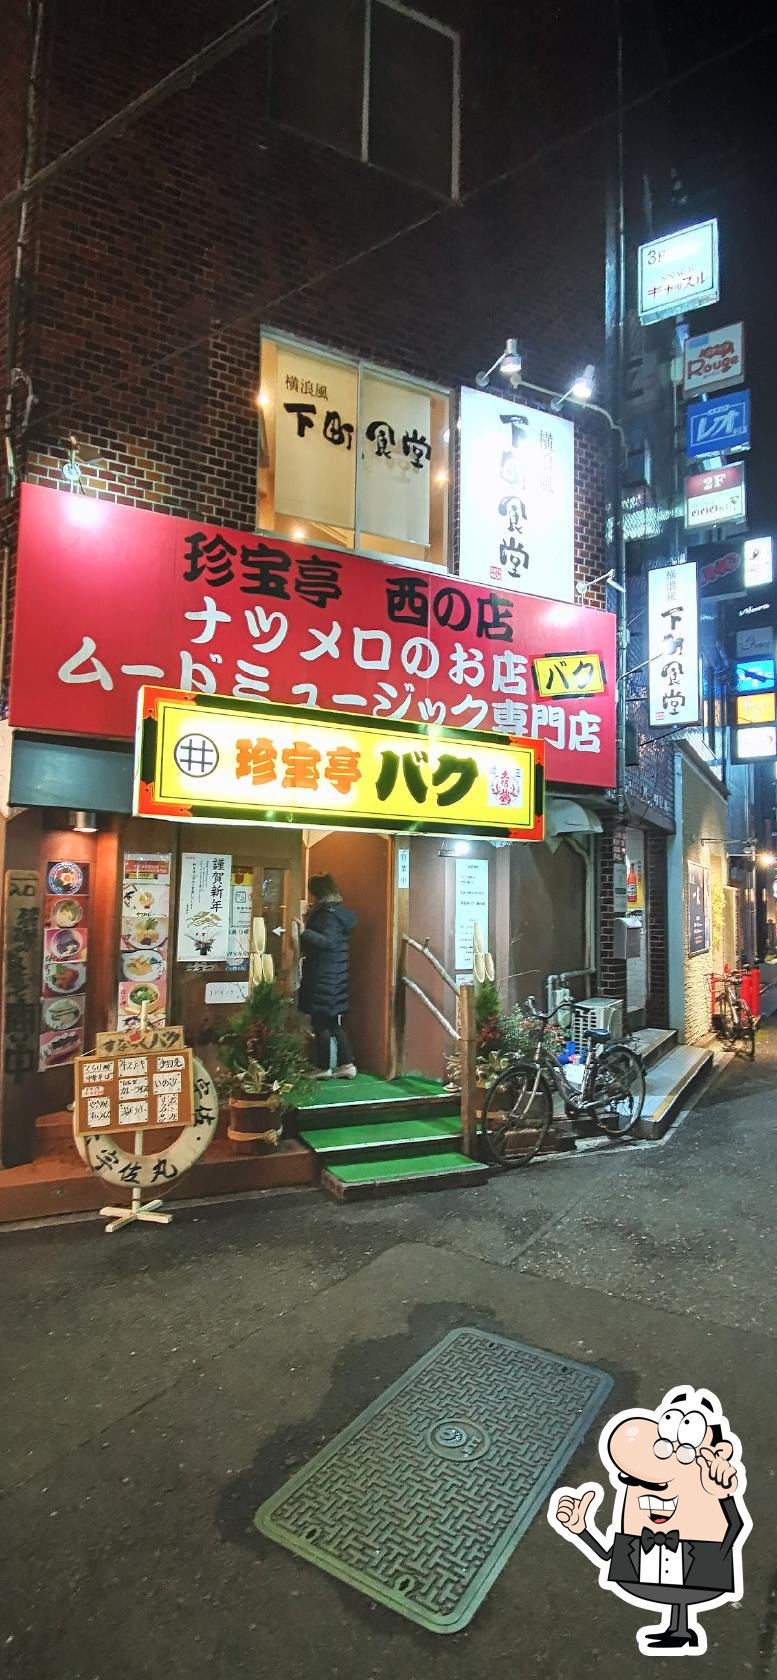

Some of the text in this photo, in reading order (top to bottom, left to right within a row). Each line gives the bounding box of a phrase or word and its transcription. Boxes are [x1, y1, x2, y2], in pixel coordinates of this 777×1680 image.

[648, 250, 665, 265] 3F
[284, 373, 328, 401] 横浪風
[688, 355, 739, 379] Rouge
[284, 402, 432, 469] 下町食堂
[696, 410, 738, 442] レオ
[703, 473, 726, 490] 2F
[184, 532, 514, 643] 珍宝亭 西の店
[184, 596, 528, 696] ナツメロのお店
[58, 636, 602, 754] ムードミュージック専門店
[546, 660, 595, 691] バク
[235, 737, 479, 807] 珍宝亭 バク
[209, 857, 225, 913] 謹賀新年
